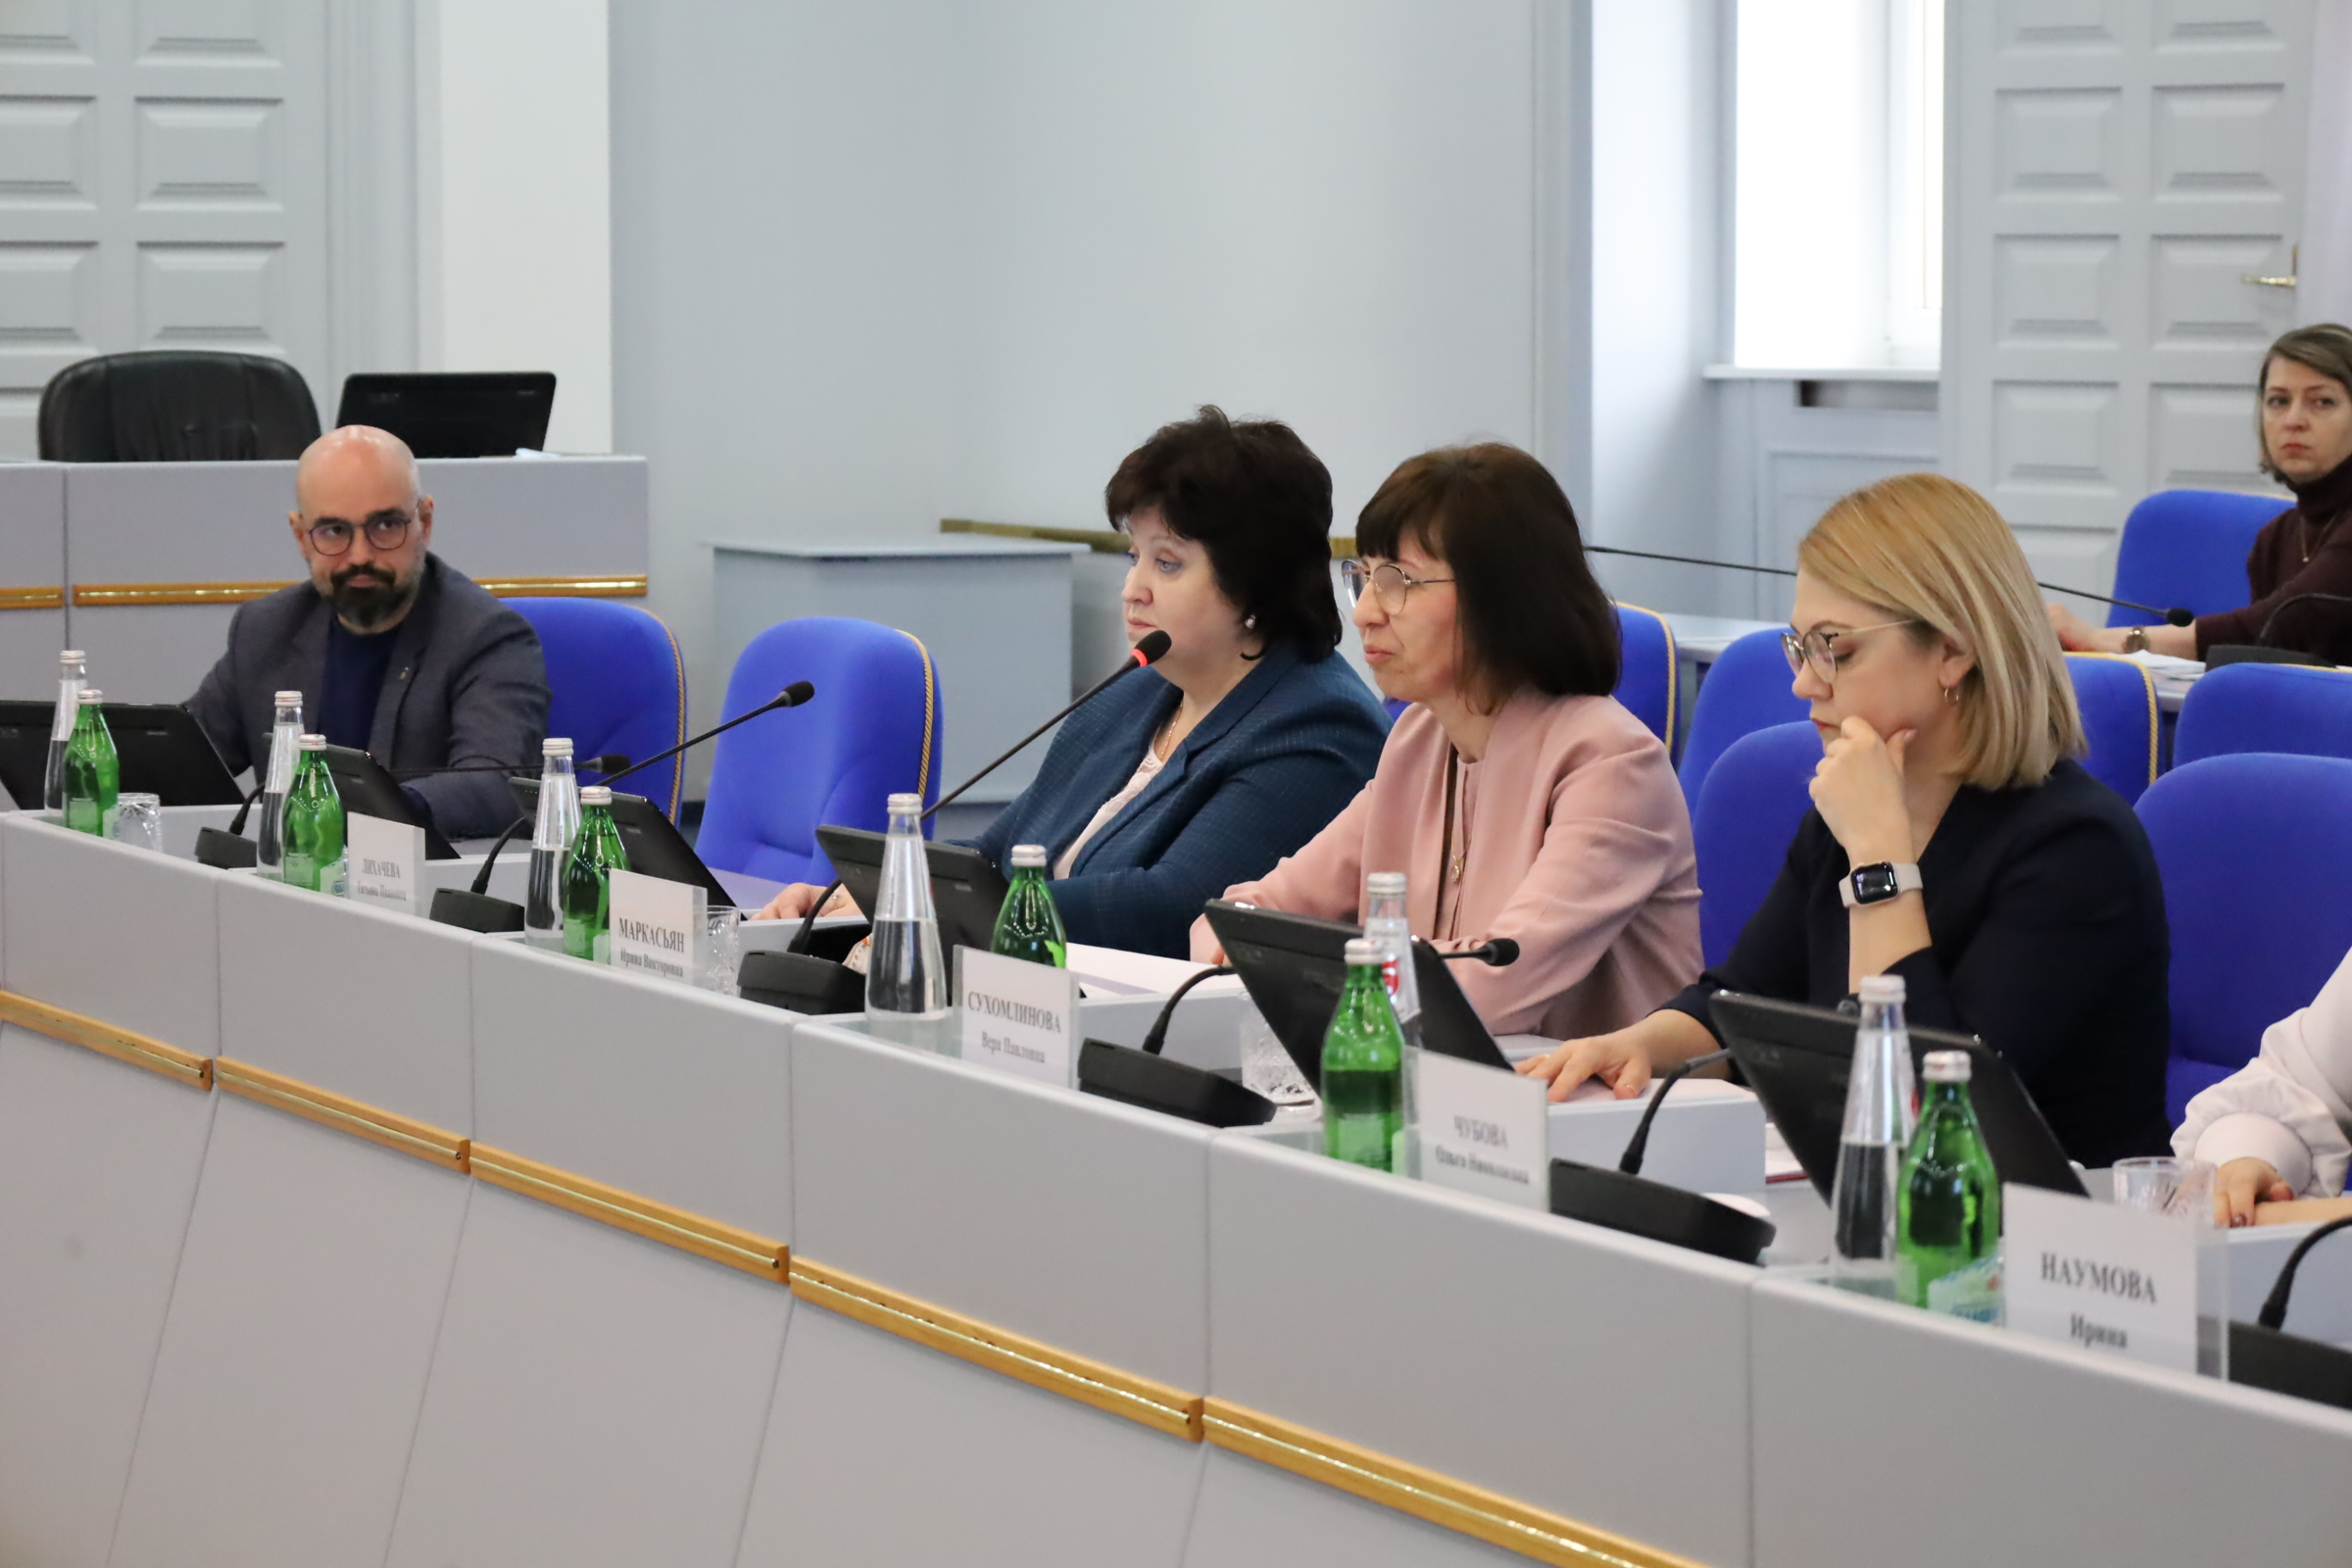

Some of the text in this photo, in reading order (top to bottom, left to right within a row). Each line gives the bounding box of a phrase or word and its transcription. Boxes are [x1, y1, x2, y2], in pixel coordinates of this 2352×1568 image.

[362, 858, 401, 878] ЛИХАЧЕВА
[618, 917, 684, 953] МАРКАСЬЯН
[620, 948, 683, 977] Ирина Викторовна
[967, 991, 1061, 1033] СУХОМЛИНОВА
[982, 1031, 1002, 1054] Вера
[2041, 1251, 2157, 1304] НАУМОВА
[2070, 1312, 2128, 1348] Ирина
